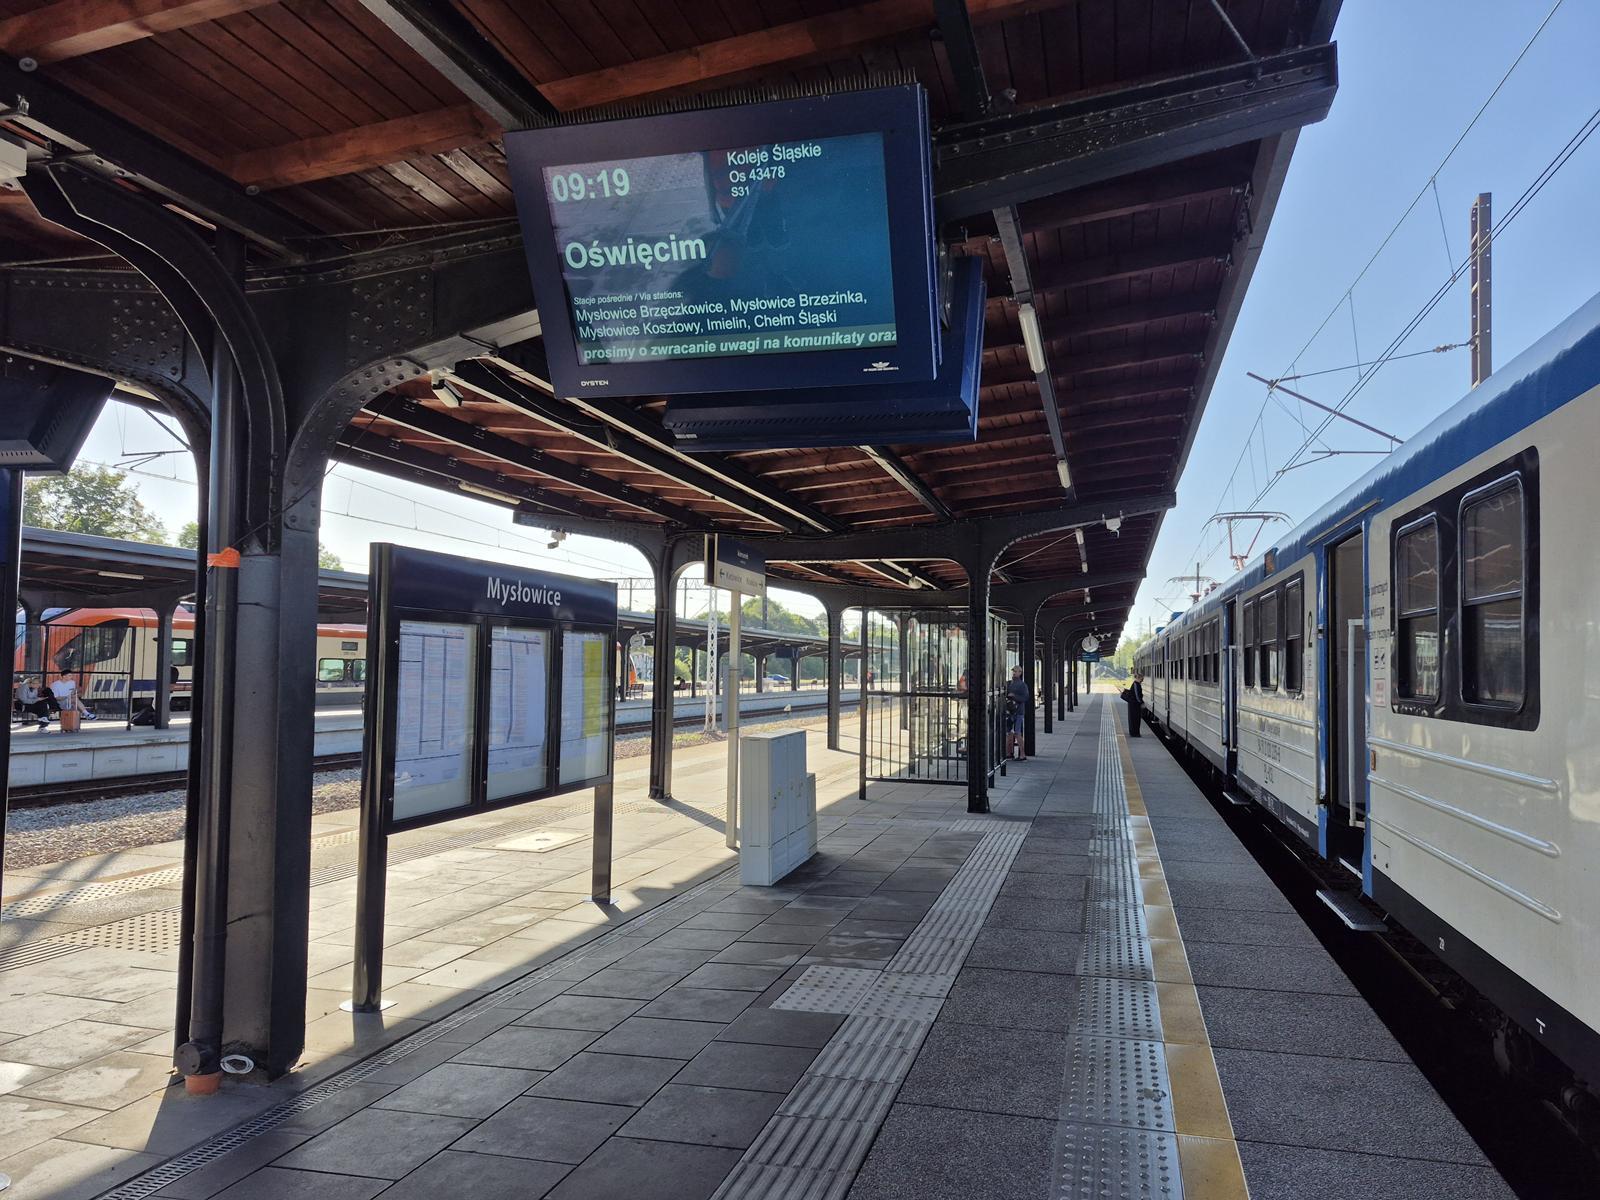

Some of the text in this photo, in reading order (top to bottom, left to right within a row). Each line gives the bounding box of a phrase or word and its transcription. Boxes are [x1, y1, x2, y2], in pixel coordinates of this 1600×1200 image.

[727, 143, 822, 166] Koleje Śląskie
[552, 168, 630, 202] 09:19
[729, 165, 786, 183] Os 43478
[731, 186, 750, 197] S31
[565, 234, 706, 270] Oświęcim
[574, 296, 596, 306] Stacje
[597, 293, 633, 305] pośrednie
[639, 292, 651, 301] Via
[653, 290, 684, 300] stations:
[576, 290, 867, 324] Mysłowice Brzęczkowice, Mysłowice Brzezinka,
[579, 309, 837, 340] Mysłowice Kosztowy, Imielin, Chełm Śląski
[584, 330, 897, 360] prosimy o zwracanie uwagi na komunikaty oraz
[487, 576, 561, 606] Mysłowice
